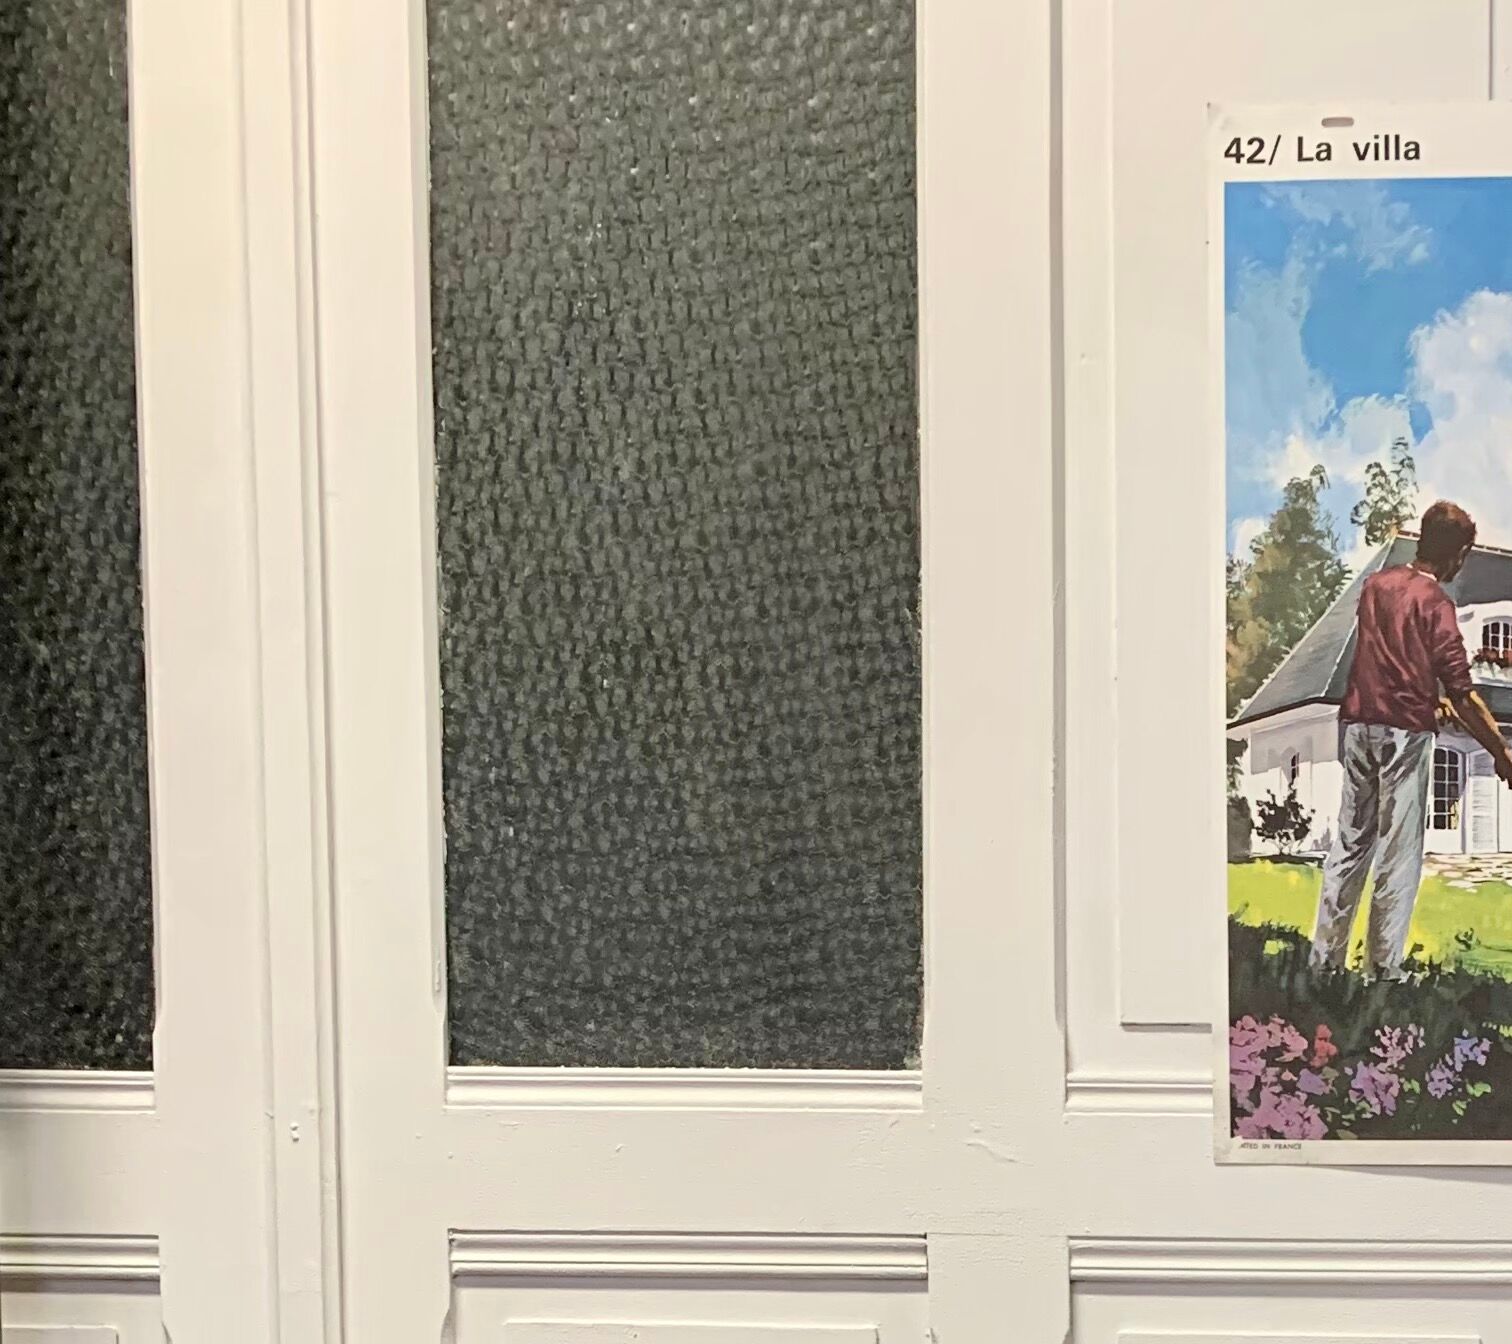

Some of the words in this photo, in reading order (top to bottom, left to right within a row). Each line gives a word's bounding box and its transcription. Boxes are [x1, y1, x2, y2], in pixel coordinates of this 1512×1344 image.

[1223, 134, 1282, 166] 42/
[1296, 135, 1333, 163] La
[1352, 134, 1421, 161] villa
